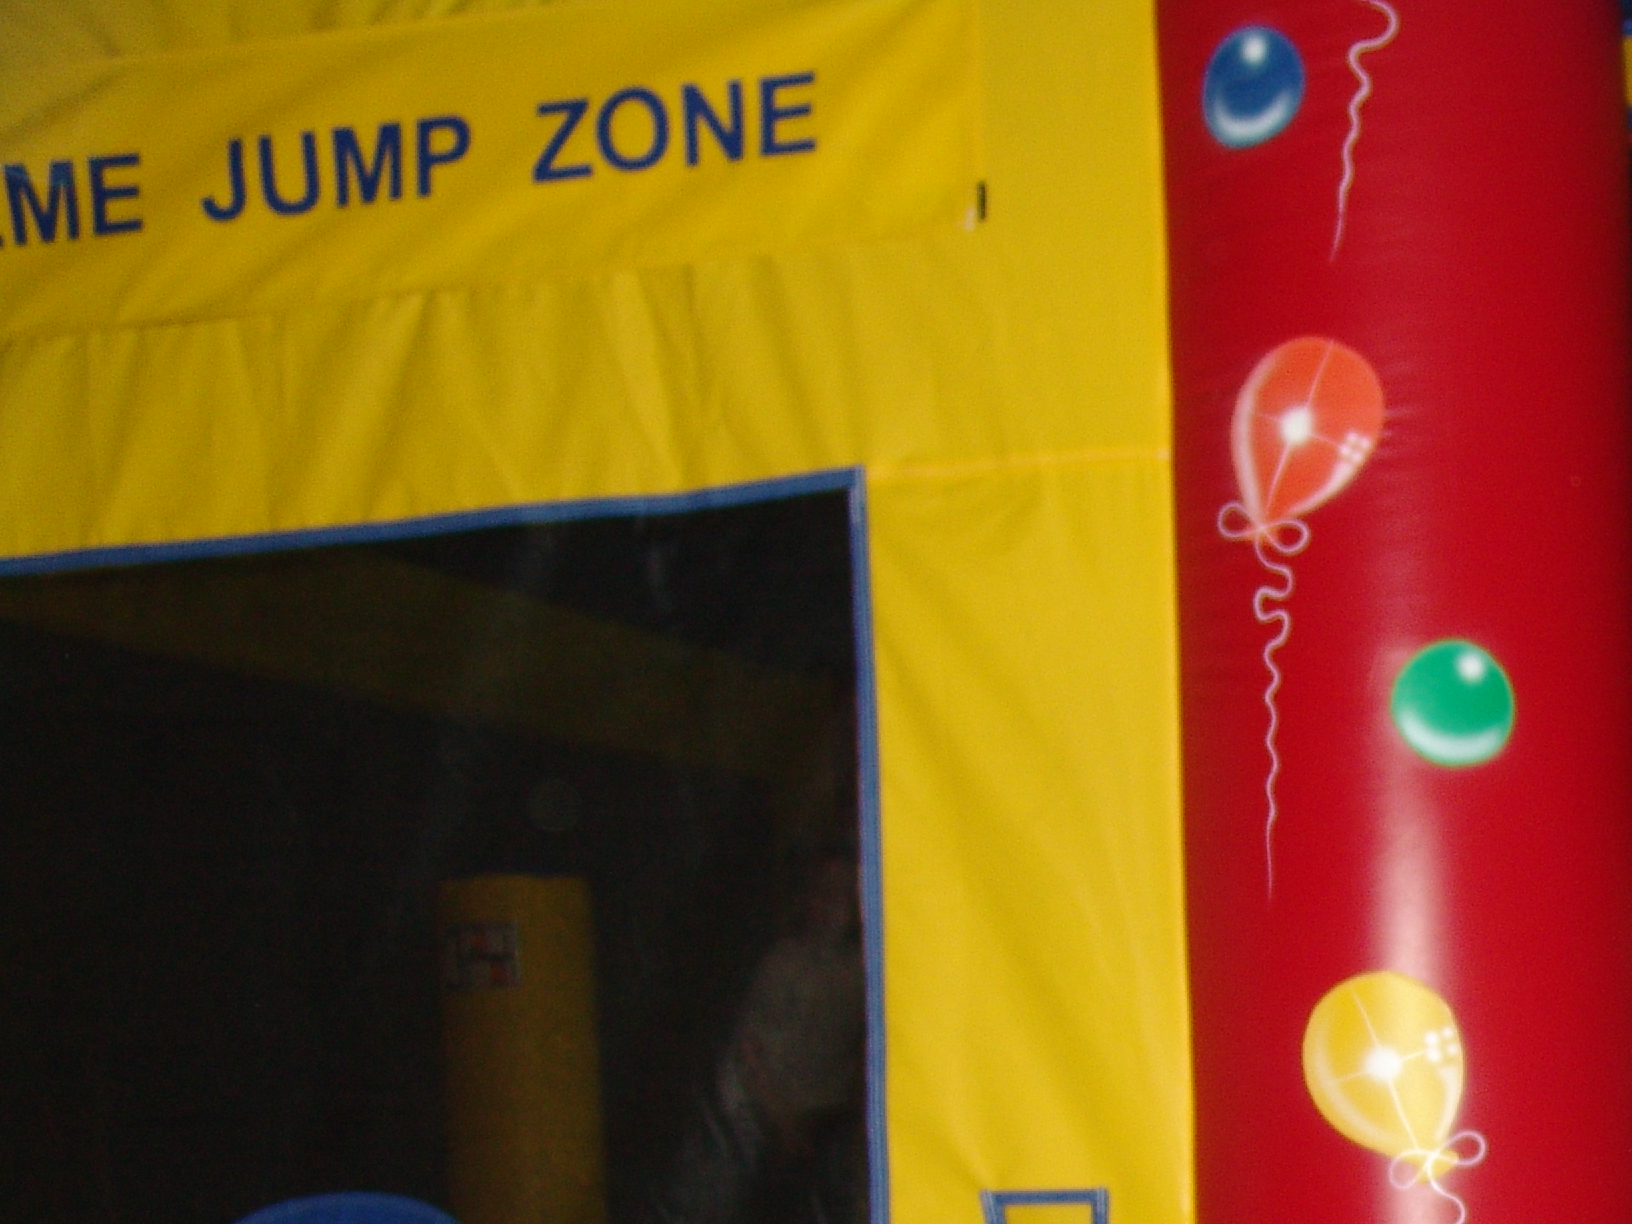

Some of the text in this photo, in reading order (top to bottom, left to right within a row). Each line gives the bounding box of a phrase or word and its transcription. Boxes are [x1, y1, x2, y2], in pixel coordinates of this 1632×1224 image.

[0, 71, 817, 248] ME JUMP ZONE
